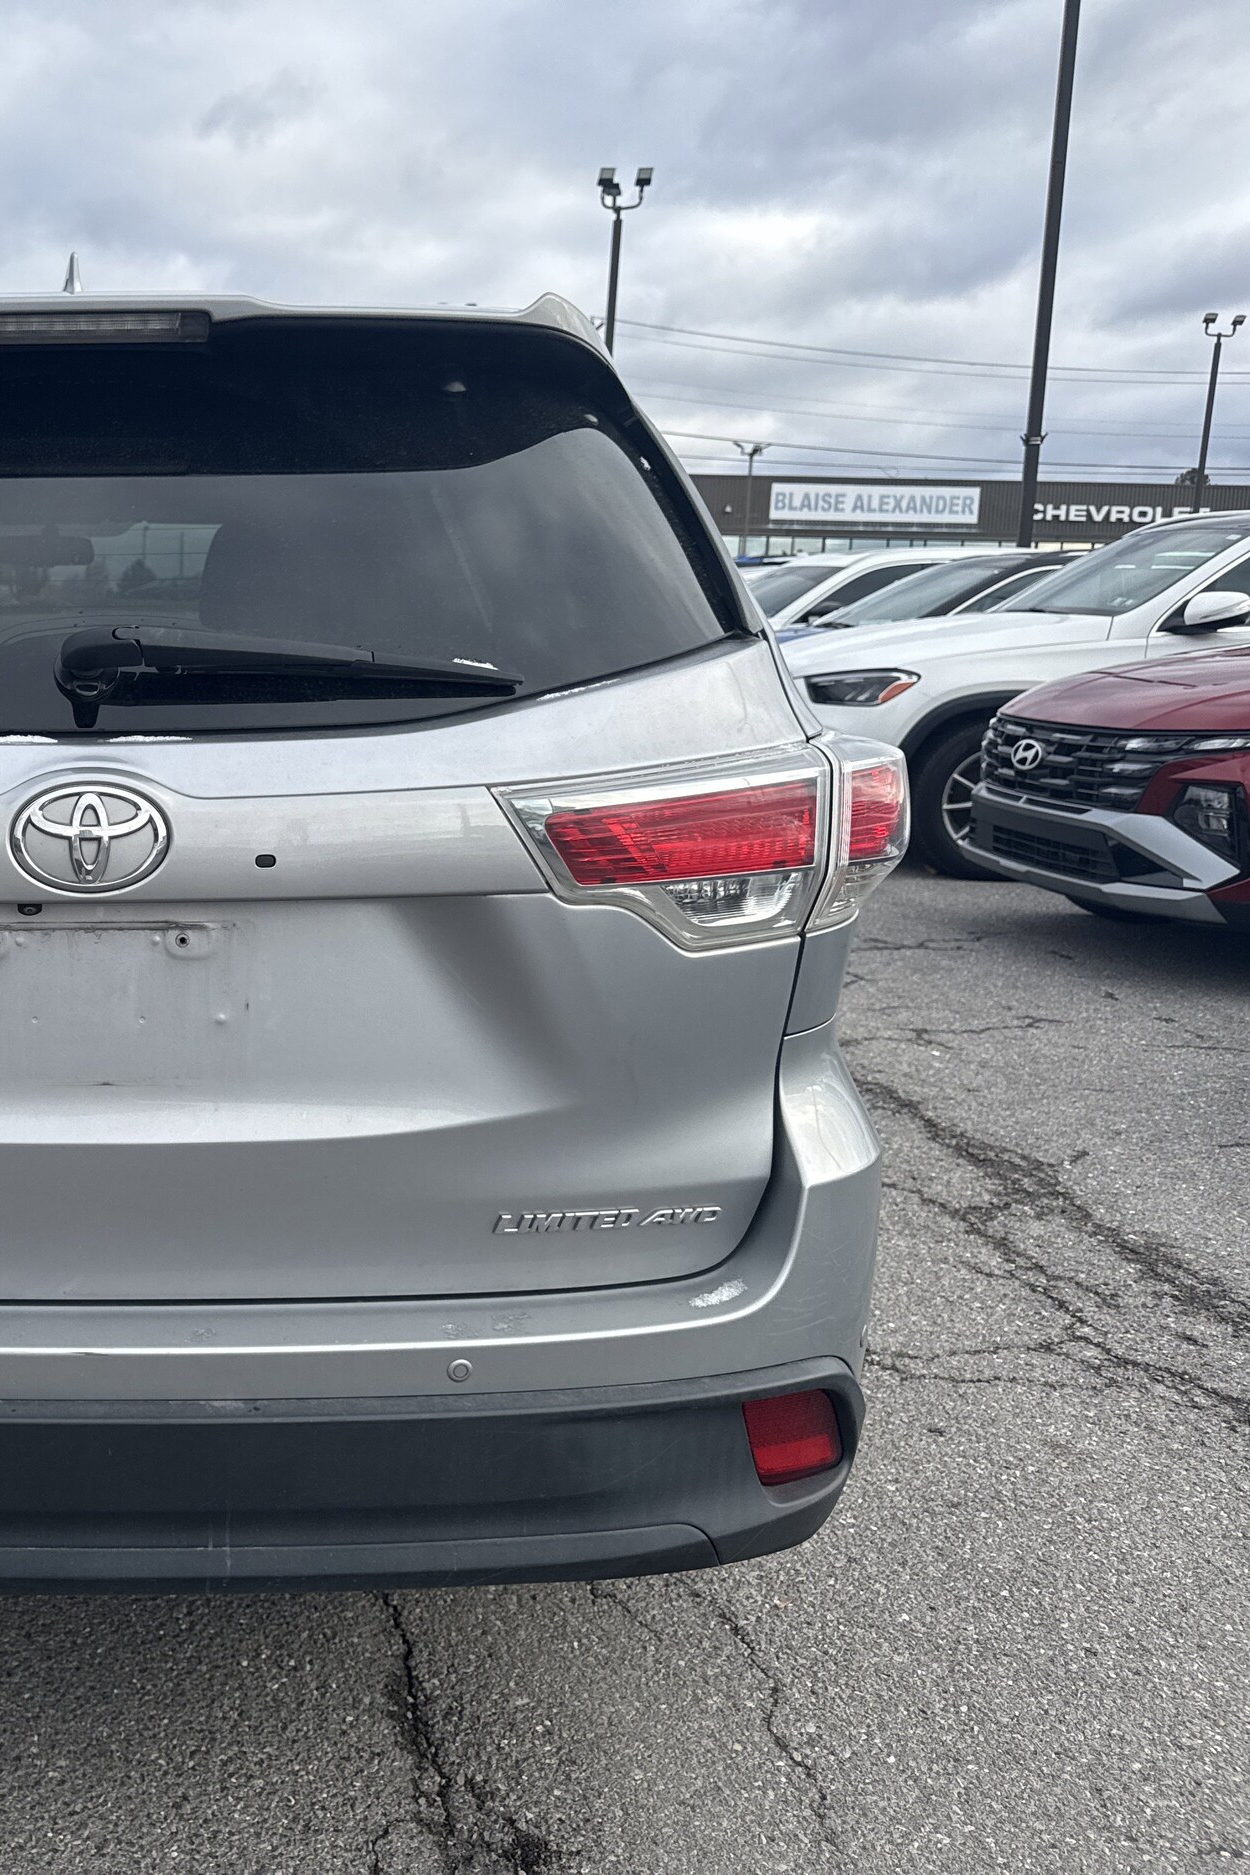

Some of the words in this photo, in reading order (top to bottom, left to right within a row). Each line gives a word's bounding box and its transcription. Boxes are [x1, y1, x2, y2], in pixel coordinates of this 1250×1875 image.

[774, 491, 846, 513] BLAISE
[851, 493, 975, 516] ALEXANDER
[1033, 503, 1211, 523] CHEVROLE
[493, 1207, 639, 1234] LIMITED
[638, 1205, 723, 1227] AWD
